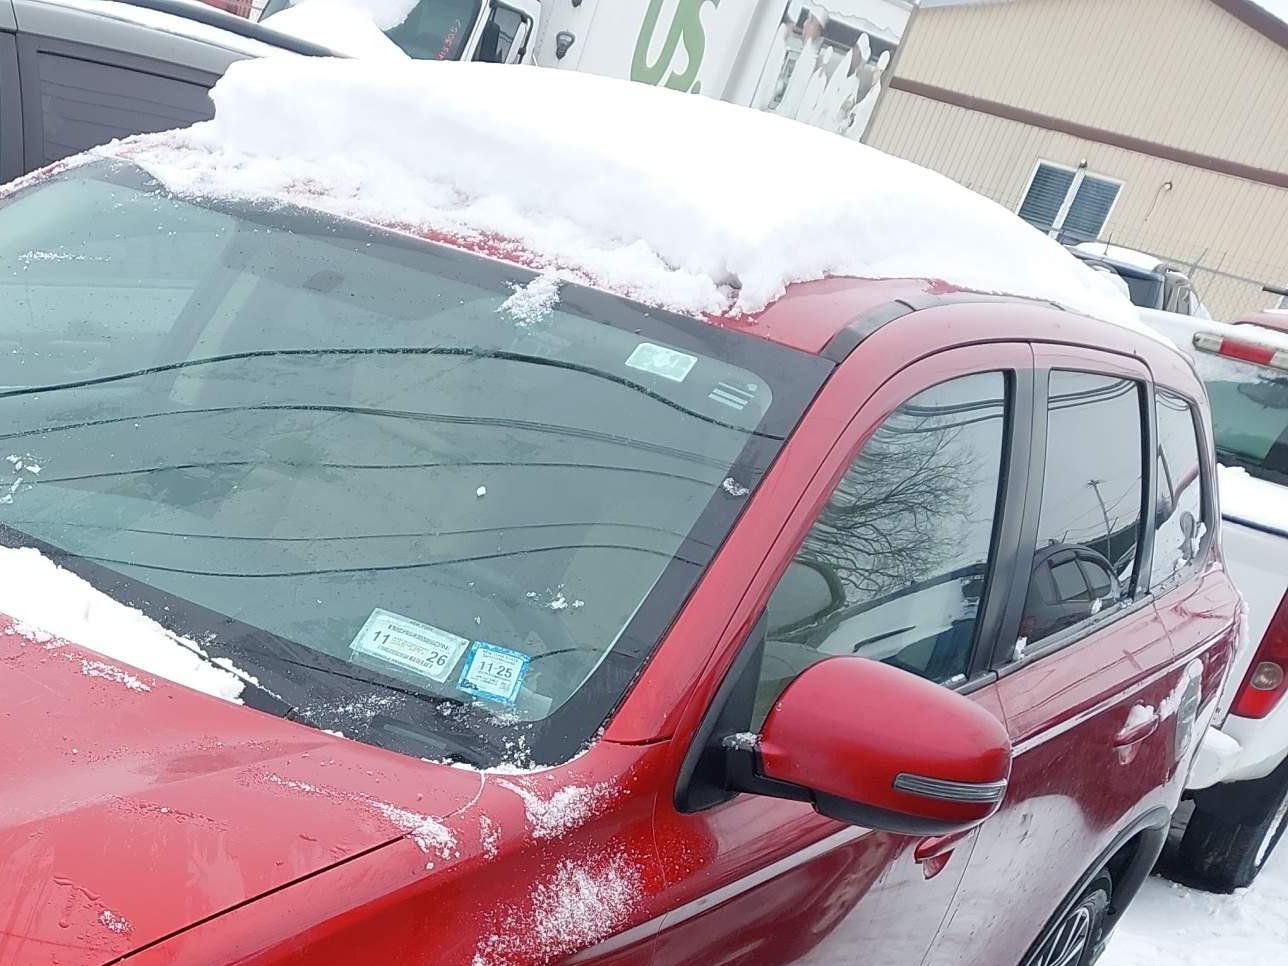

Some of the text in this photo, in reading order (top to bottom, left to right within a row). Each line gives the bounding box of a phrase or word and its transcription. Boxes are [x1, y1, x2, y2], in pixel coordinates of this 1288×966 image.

[372, 630, 391, 646] 11
[426, 651, 449, 667] 26
[478, 660, 514, 680] 11-25
